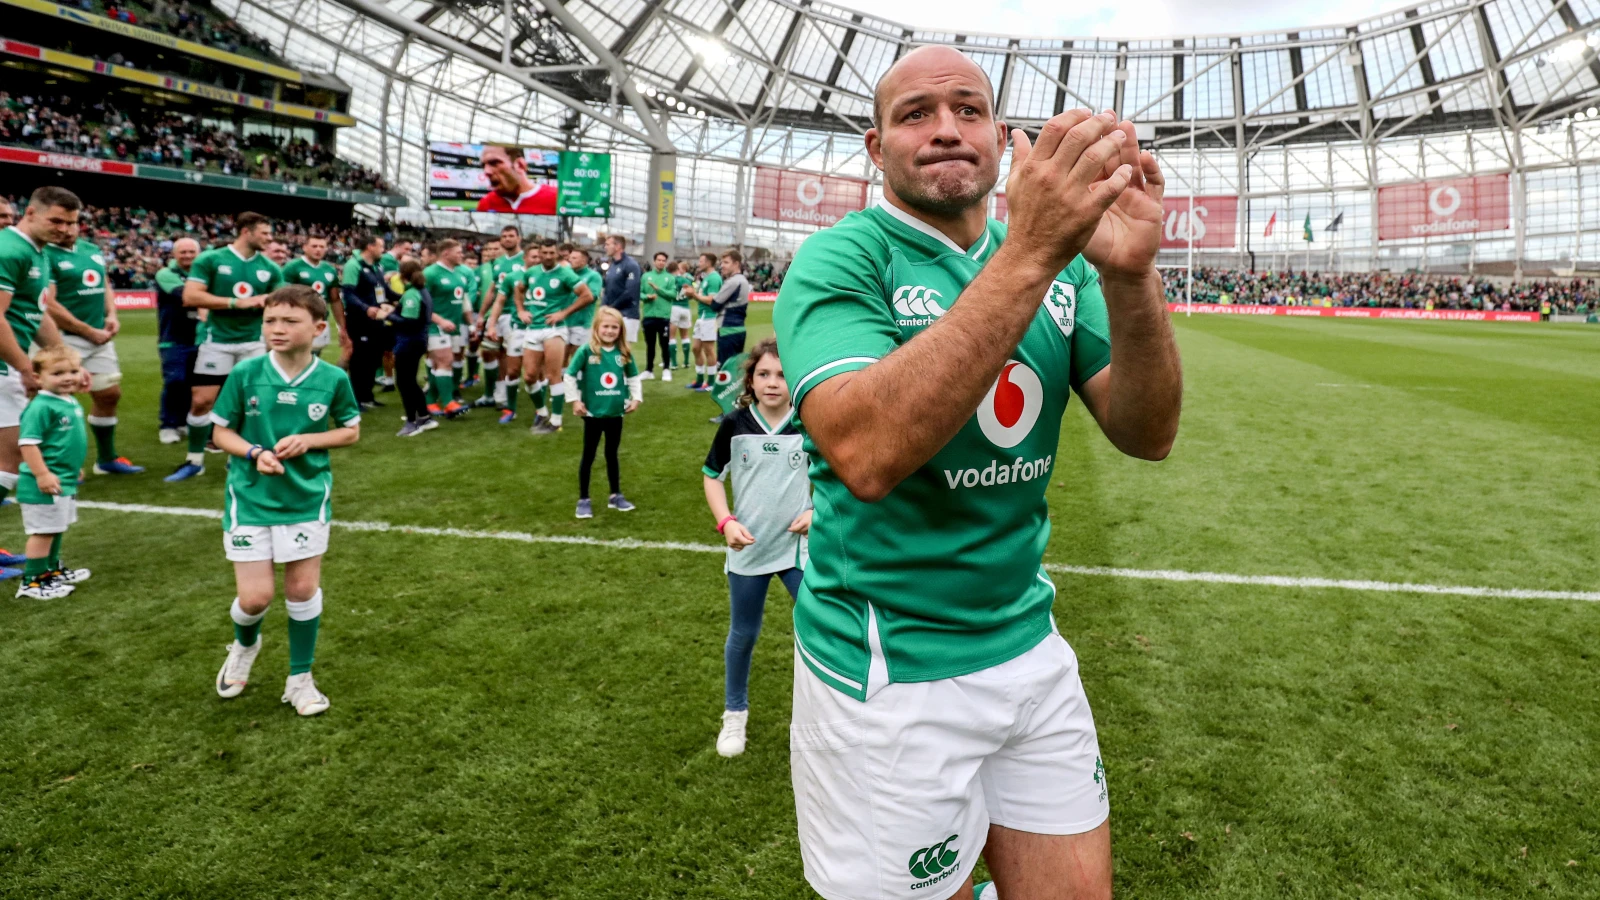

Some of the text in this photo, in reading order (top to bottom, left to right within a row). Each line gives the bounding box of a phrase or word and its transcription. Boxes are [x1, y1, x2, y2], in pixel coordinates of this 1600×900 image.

[573, 167, 600, 179] 80:00
[661, 197, 670, 229] AVIVA
[780, 206, 838, 224] vodafone
[1410, 218, 1480, 234] vodafone
[114, 295, 151, 307] dafone
[896, 316, 935, 327] canterb
[944, 455, 1052, 490] vodafone
[911, 860, 961, 890] canterbury
